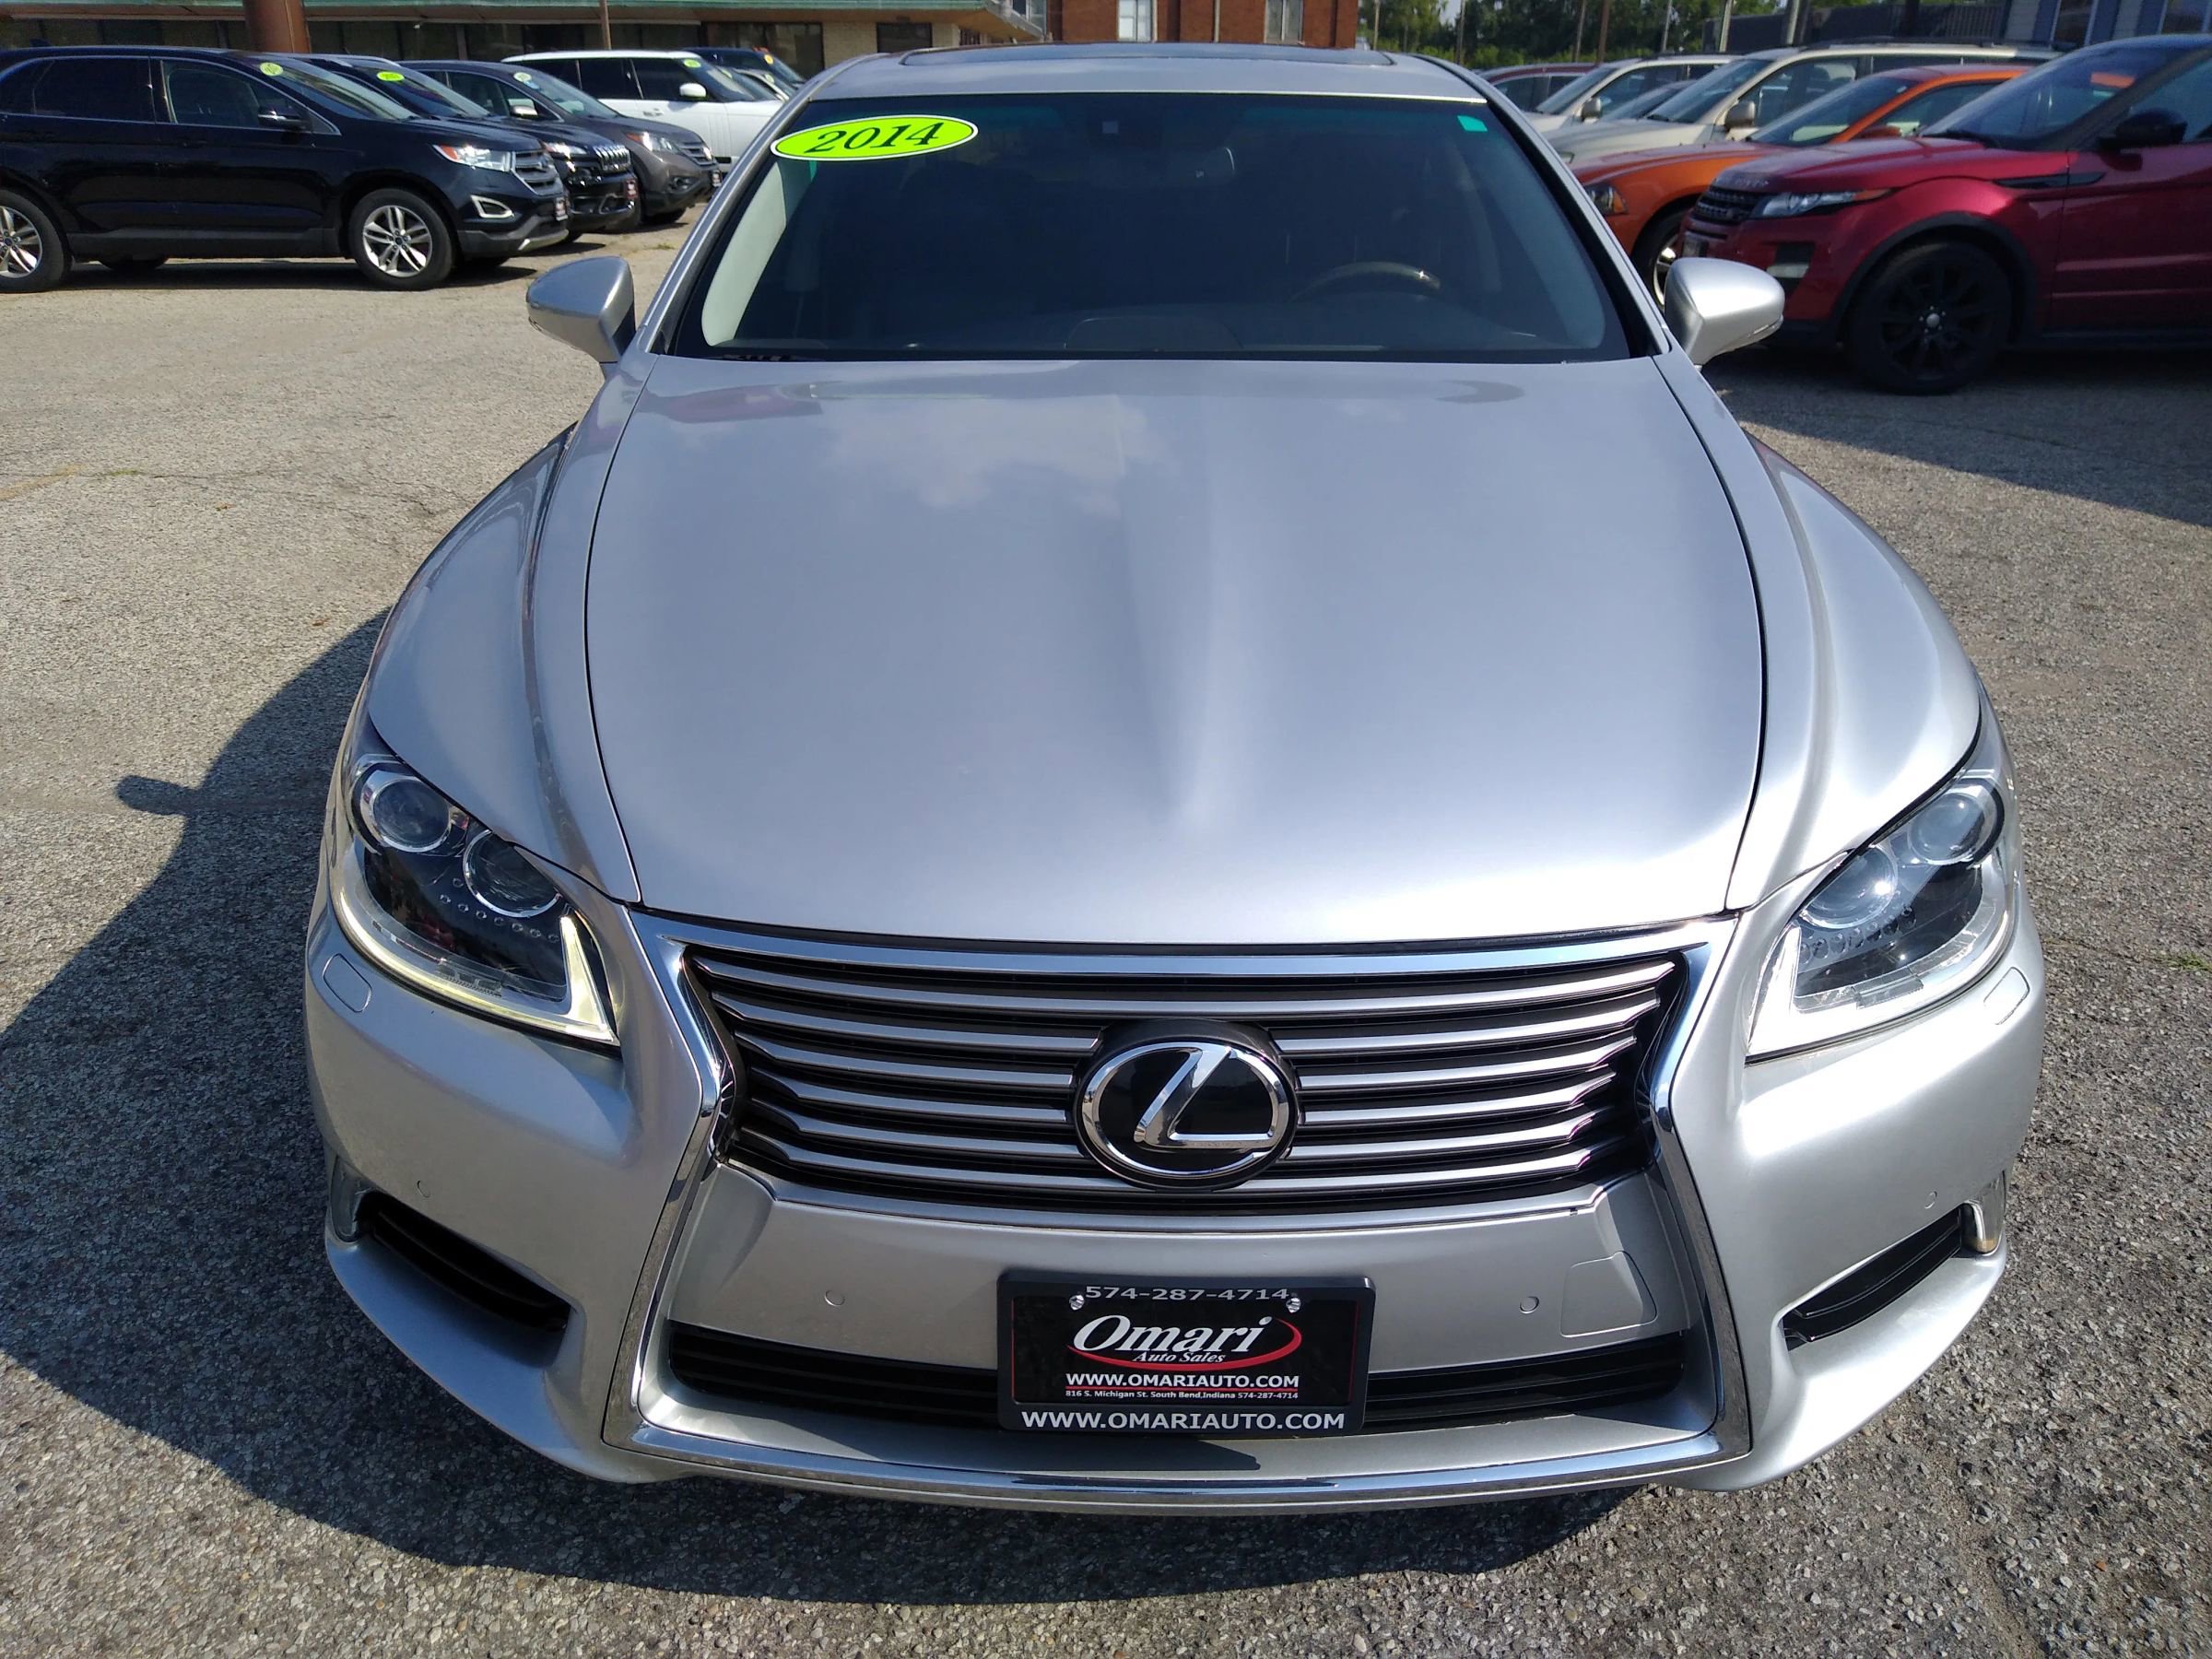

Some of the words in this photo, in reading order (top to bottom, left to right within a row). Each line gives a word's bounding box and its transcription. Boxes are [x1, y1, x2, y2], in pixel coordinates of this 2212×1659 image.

[803, 122, 945, 154] 2014
[1085, 1286, 1289, 1301] 574-287-4714
[1073, 1314, 1273, 1353] Omari
[1132, 1352, 1175, 1362] Auto
[1179, 1351, 1226, 1364] Sales
[1065, 1373, 1300, 1388] WWW.OMARIAUTO.COM
[1094, 1391, 1135, 1399] Michigan
[1021, 1411, 1345, 1430] WWW.OMARIAUTO.COM
